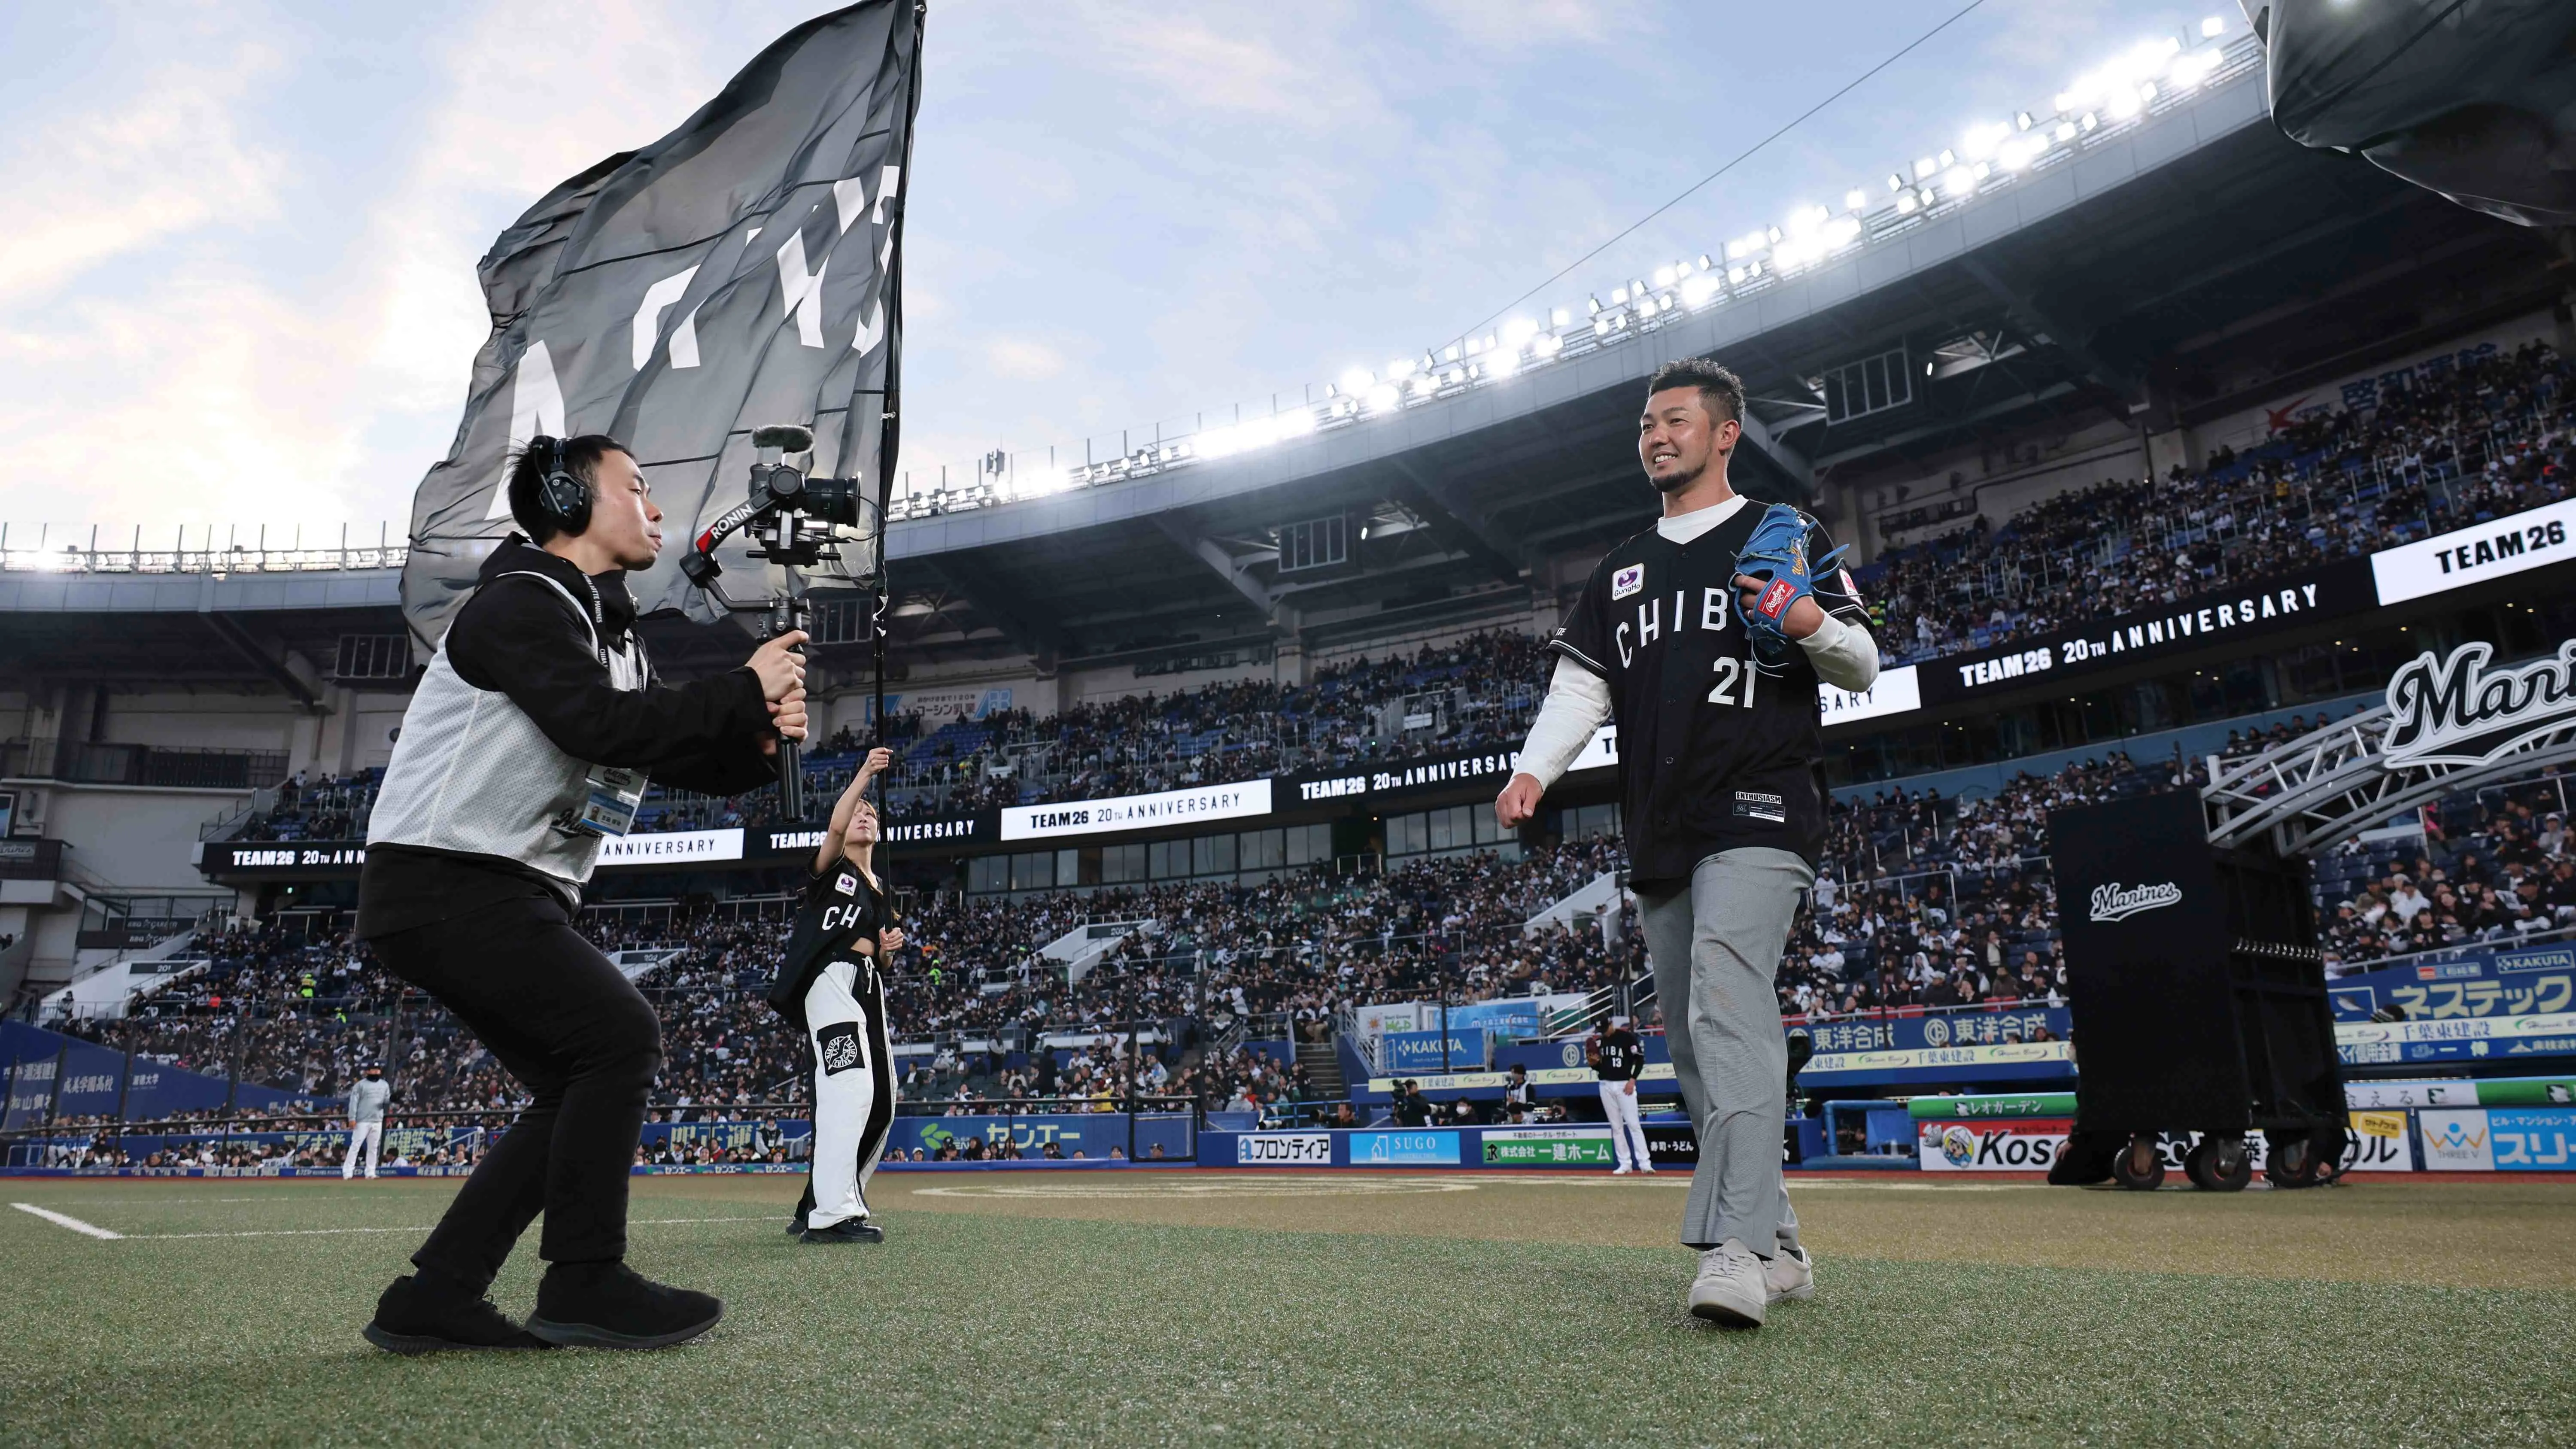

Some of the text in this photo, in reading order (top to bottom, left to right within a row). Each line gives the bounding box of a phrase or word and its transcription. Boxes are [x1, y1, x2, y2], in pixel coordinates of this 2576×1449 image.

[711, 504, 754, 539] RONIN
[2435, 520, 2566, 574] TEAM26
[1614, 583, 1641, 598] GungHo
[1765, 583, 1786, 613] Rawlings
[1616, 587, 1728, 669] CHIB
[1959, 583, 2317, 687] TEAM26 20TH ANNIVERSARY
[1708, 656, 1757, 708] 21
[917, 702, 975, 717] コーシン乳業
[1301, 776, 1366, 800] TEAM26
[1373, 773, 1401, 791] 20TH
[1736, 792, 1781, 804] ENTHUSIASM
[1031, 793, 1240, 829] TEAM26 20TH ANNIVERSARY
[605, 838, 715, 856] ANNIVERSARY
[233, 851, 295, 866] TEAM26
[302, 850, 330, 864] 20TH
[836, 884, 854, 895] GungHo
[2091, 882, 2182, 917] Marines
[1111, 927, 1126, 936] 203
[2512, 954, 2569, 969] KAKUTA
[2392, 976, 2572, 1021] ネステック
[1813, 1024, 1895, 1051] 東洋合成
[834, 1058, 852, 1067] CHIBA
[1612, 1057, 1622, 1068] 13
[1917, 1046, 1975, 1066] 千葉東建設
[1971, 1100, 2043, 1115] レオガーデン
[986, 1124, 1080, 1149] センエー
[1394, 1137, 1437, 1150] SUGO
[1254, 1139, 1330, 1160] フロンティア
[1501, 1143, 1611, 1161] 株式会社 一建ホーム
[2437, 1150, 2479, 1159] THREE V
[664, 1166, 692, 1174] センエー
[715, 1165, 742, 1173] センエー
[766, 1165, 793, 1173] センエー
